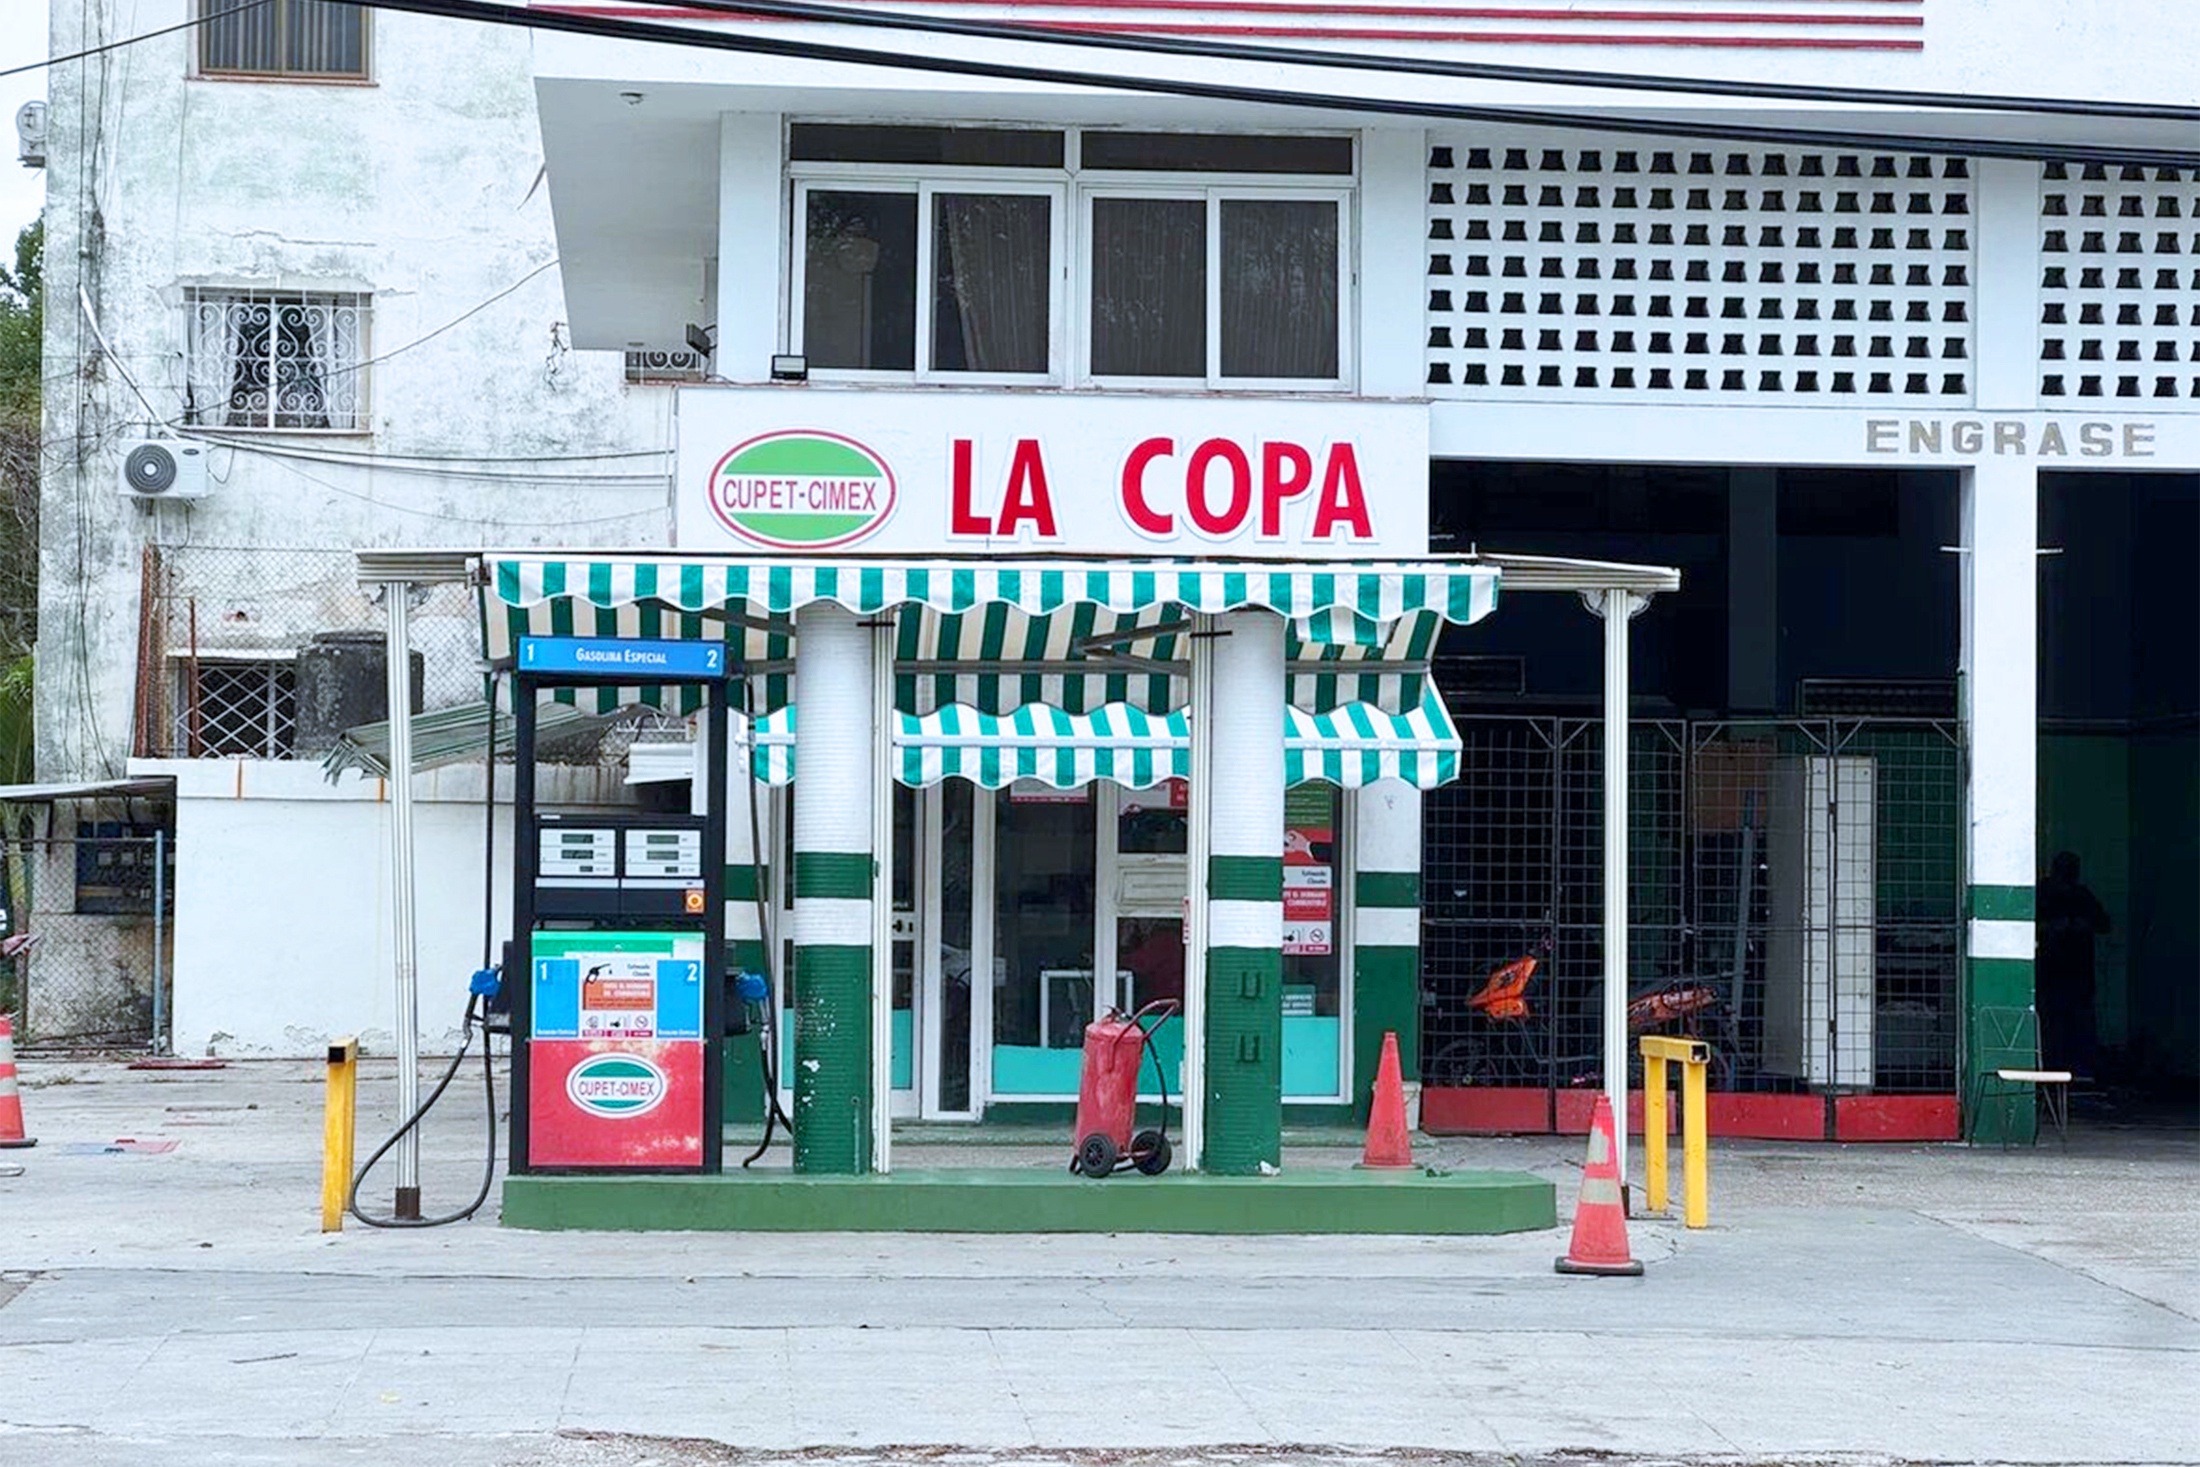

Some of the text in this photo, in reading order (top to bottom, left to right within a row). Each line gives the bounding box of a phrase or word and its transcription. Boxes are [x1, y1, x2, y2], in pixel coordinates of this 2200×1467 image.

[1865, 419, 2156, 457] ENGRASE
[723, 479, 877, 512] CUPET-CIMEX
[951, 436, 1374, 538] LA COPA
[527, 644, 534, 661] 1
[707, 650, 718, 667] 2
[540, 963, 547, 980] 1
[688, 963, 698, 981] 2
[578, 1080, 655, 1097] CUPET-CIMEX
